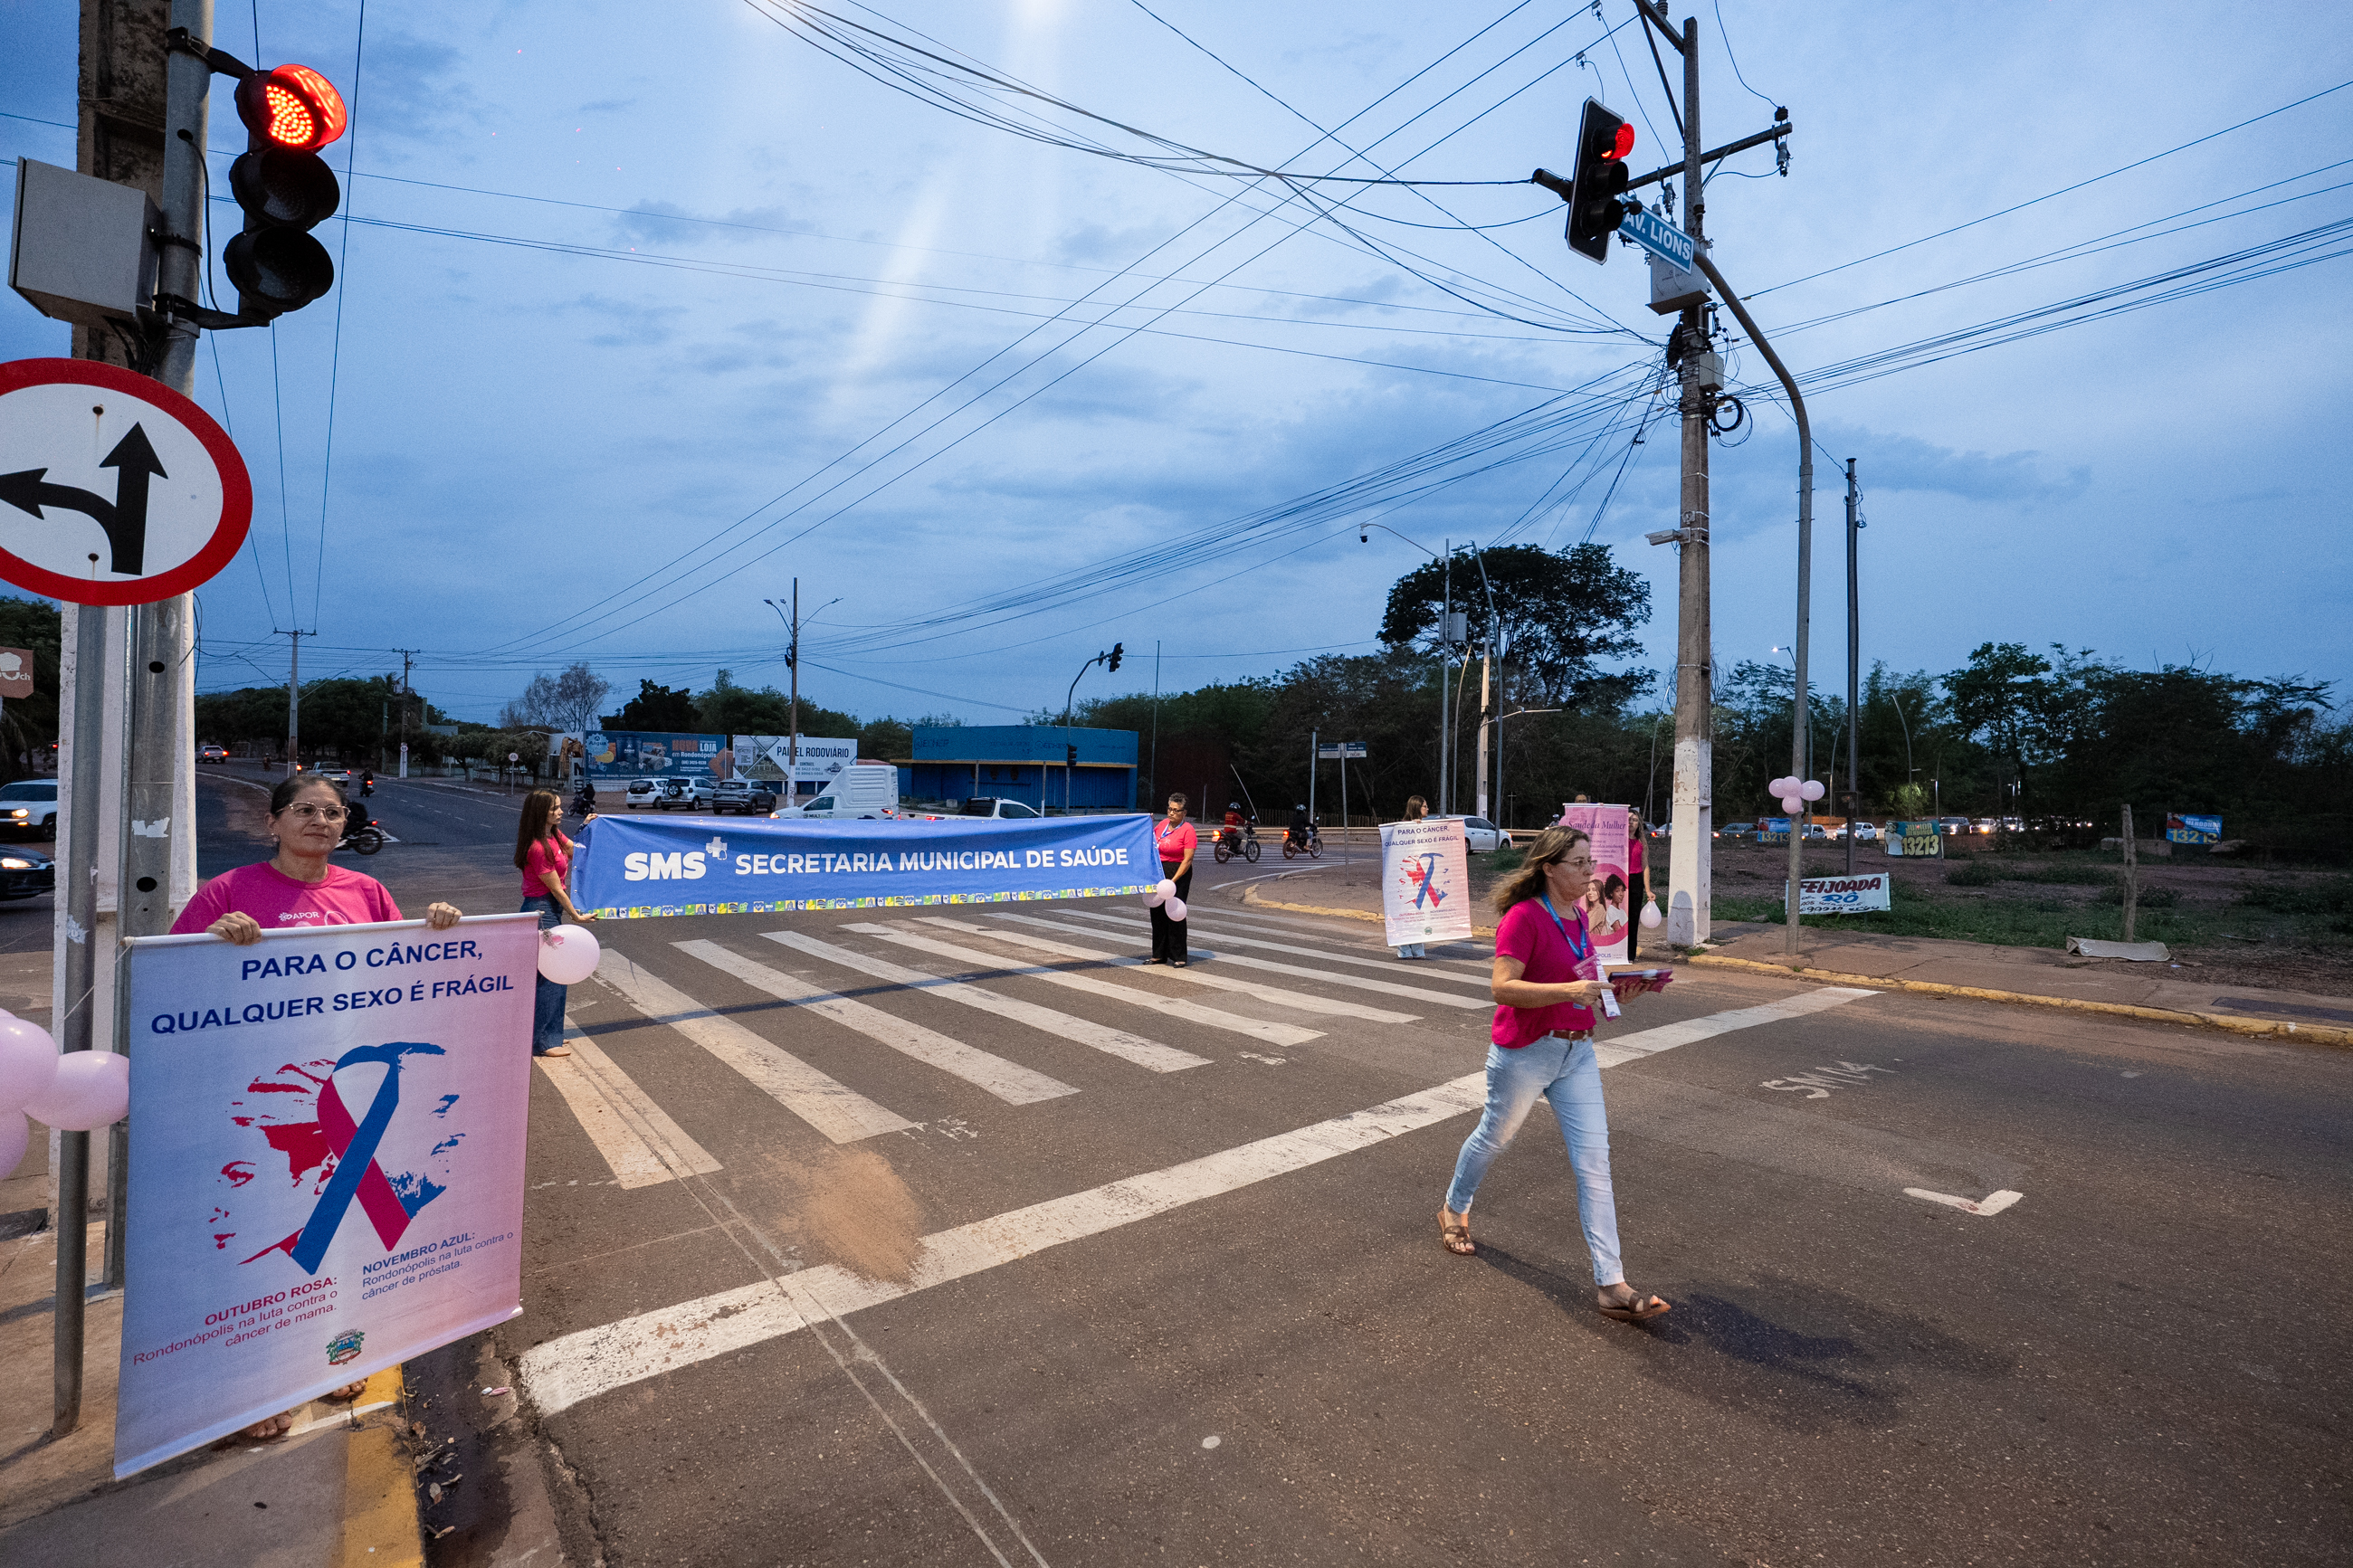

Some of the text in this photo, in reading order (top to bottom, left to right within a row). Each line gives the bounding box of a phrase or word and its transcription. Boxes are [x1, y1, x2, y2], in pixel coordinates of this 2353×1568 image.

[1624, 211, 1691, 261] AV. LIONS
[700, 743, 717, 753] LOJA
[776, 746, 850, 758] PAIEL RODOVIÁRIO
[1423, 825, 1450, 833] CÂNCER,
[1601, 820, 1626, 830] Mulher
[1761, 831, 1790, 842] 13213
[2169, 829, 2219, 844] 13213
[1385, 839, 1415, 847] QUALQUER
[1902, 834, 1939, 856] 13213
[624, 843, 1129, 881] SMS SECRETARIA MUNICIPAL DE SAÚDE
[1800, 877, 1881, 894] FEIJOADA
[1822, 891, 1859, 903] RÔ
[242, 940, 483, 981] PARA O CÂNCER,
[151, 974, 514, 1035] QUALQUER SEXO É FRÁGIL
[362, 1230, 477, 1276] NOVEMBRO AZUL:
[362, 1231, 514, 1288] Rondonópolis na luta contra o
[362, 1259, 463, 1301] câncer de próstata.
[205, 1275, 338, 1326] OUTUBRO ROSA:
[133, 1290, 338, 1366] Rondonópolis na luta contra o
[224, 1305, 338, 1348] câncer de mama.
